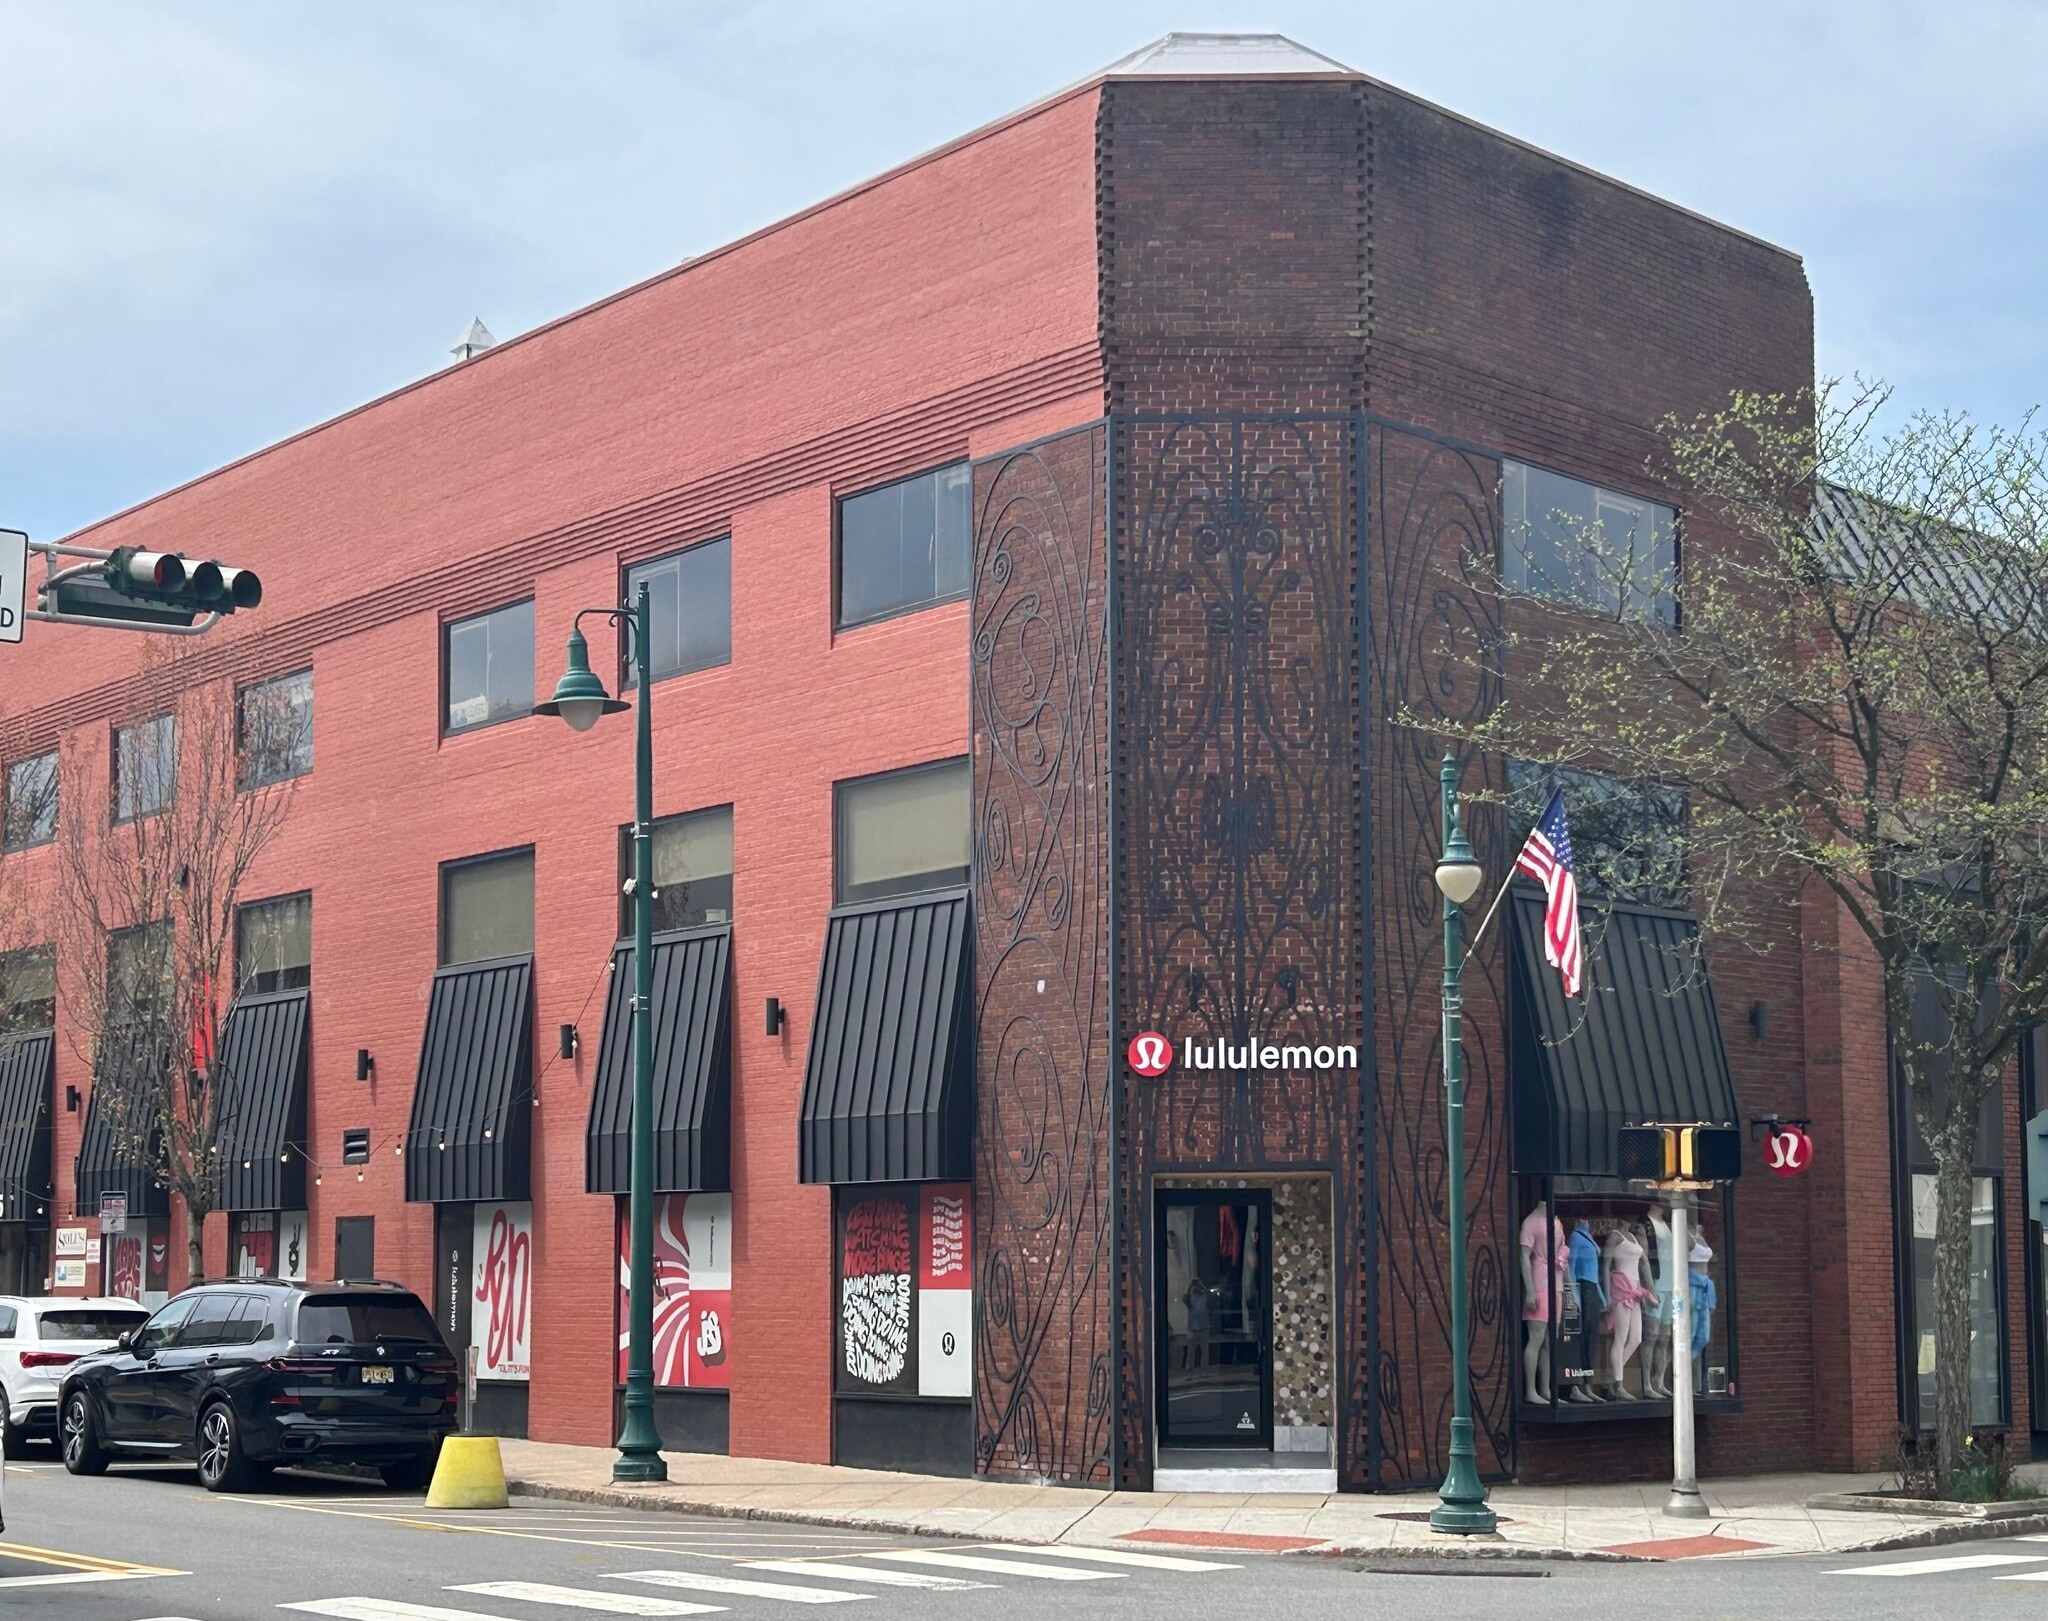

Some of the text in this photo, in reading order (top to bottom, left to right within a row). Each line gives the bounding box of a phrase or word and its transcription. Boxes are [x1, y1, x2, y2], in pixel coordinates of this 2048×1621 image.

[1184, 1037, 1357, 1069] lululemon
[845, 1228, 910, 1250] WATCHING
[843, 1248, 876, 1277] MORE
[896, 1274, 911, 1328] DOING
[876, 1311, 908, 1353] DOING
